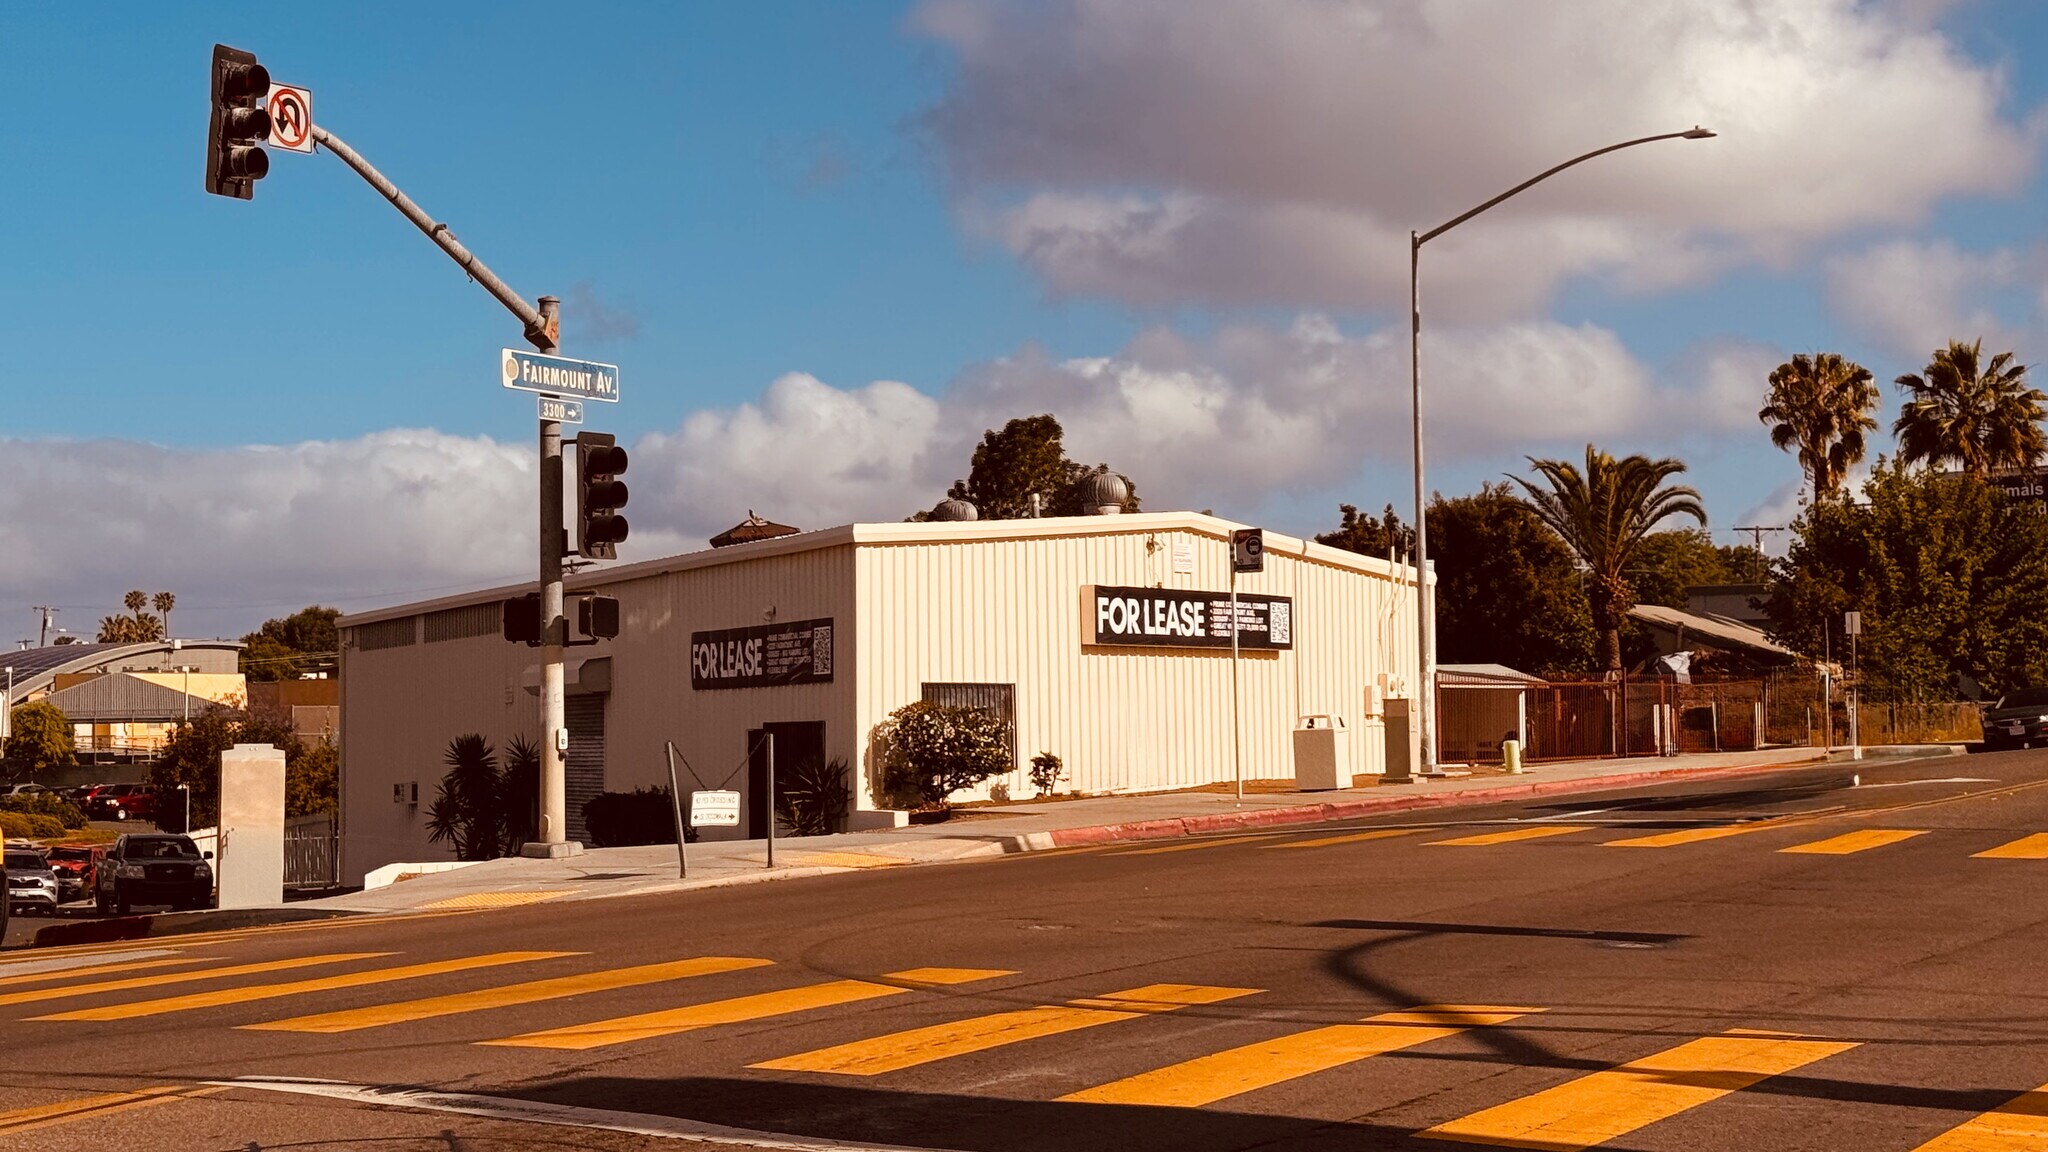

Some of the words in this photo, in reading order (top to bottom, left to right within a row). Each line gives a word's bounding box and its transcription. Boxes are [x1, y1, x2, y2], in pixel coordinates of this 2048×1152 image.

[543, 402, 565, 418] 3300
[1097, 597, 1141, 635] FOR
[1144, 599, 1205, 637] LEASE
[693, 643, 718, 679] FOR
[720, 639, 762, 678] LEASE
